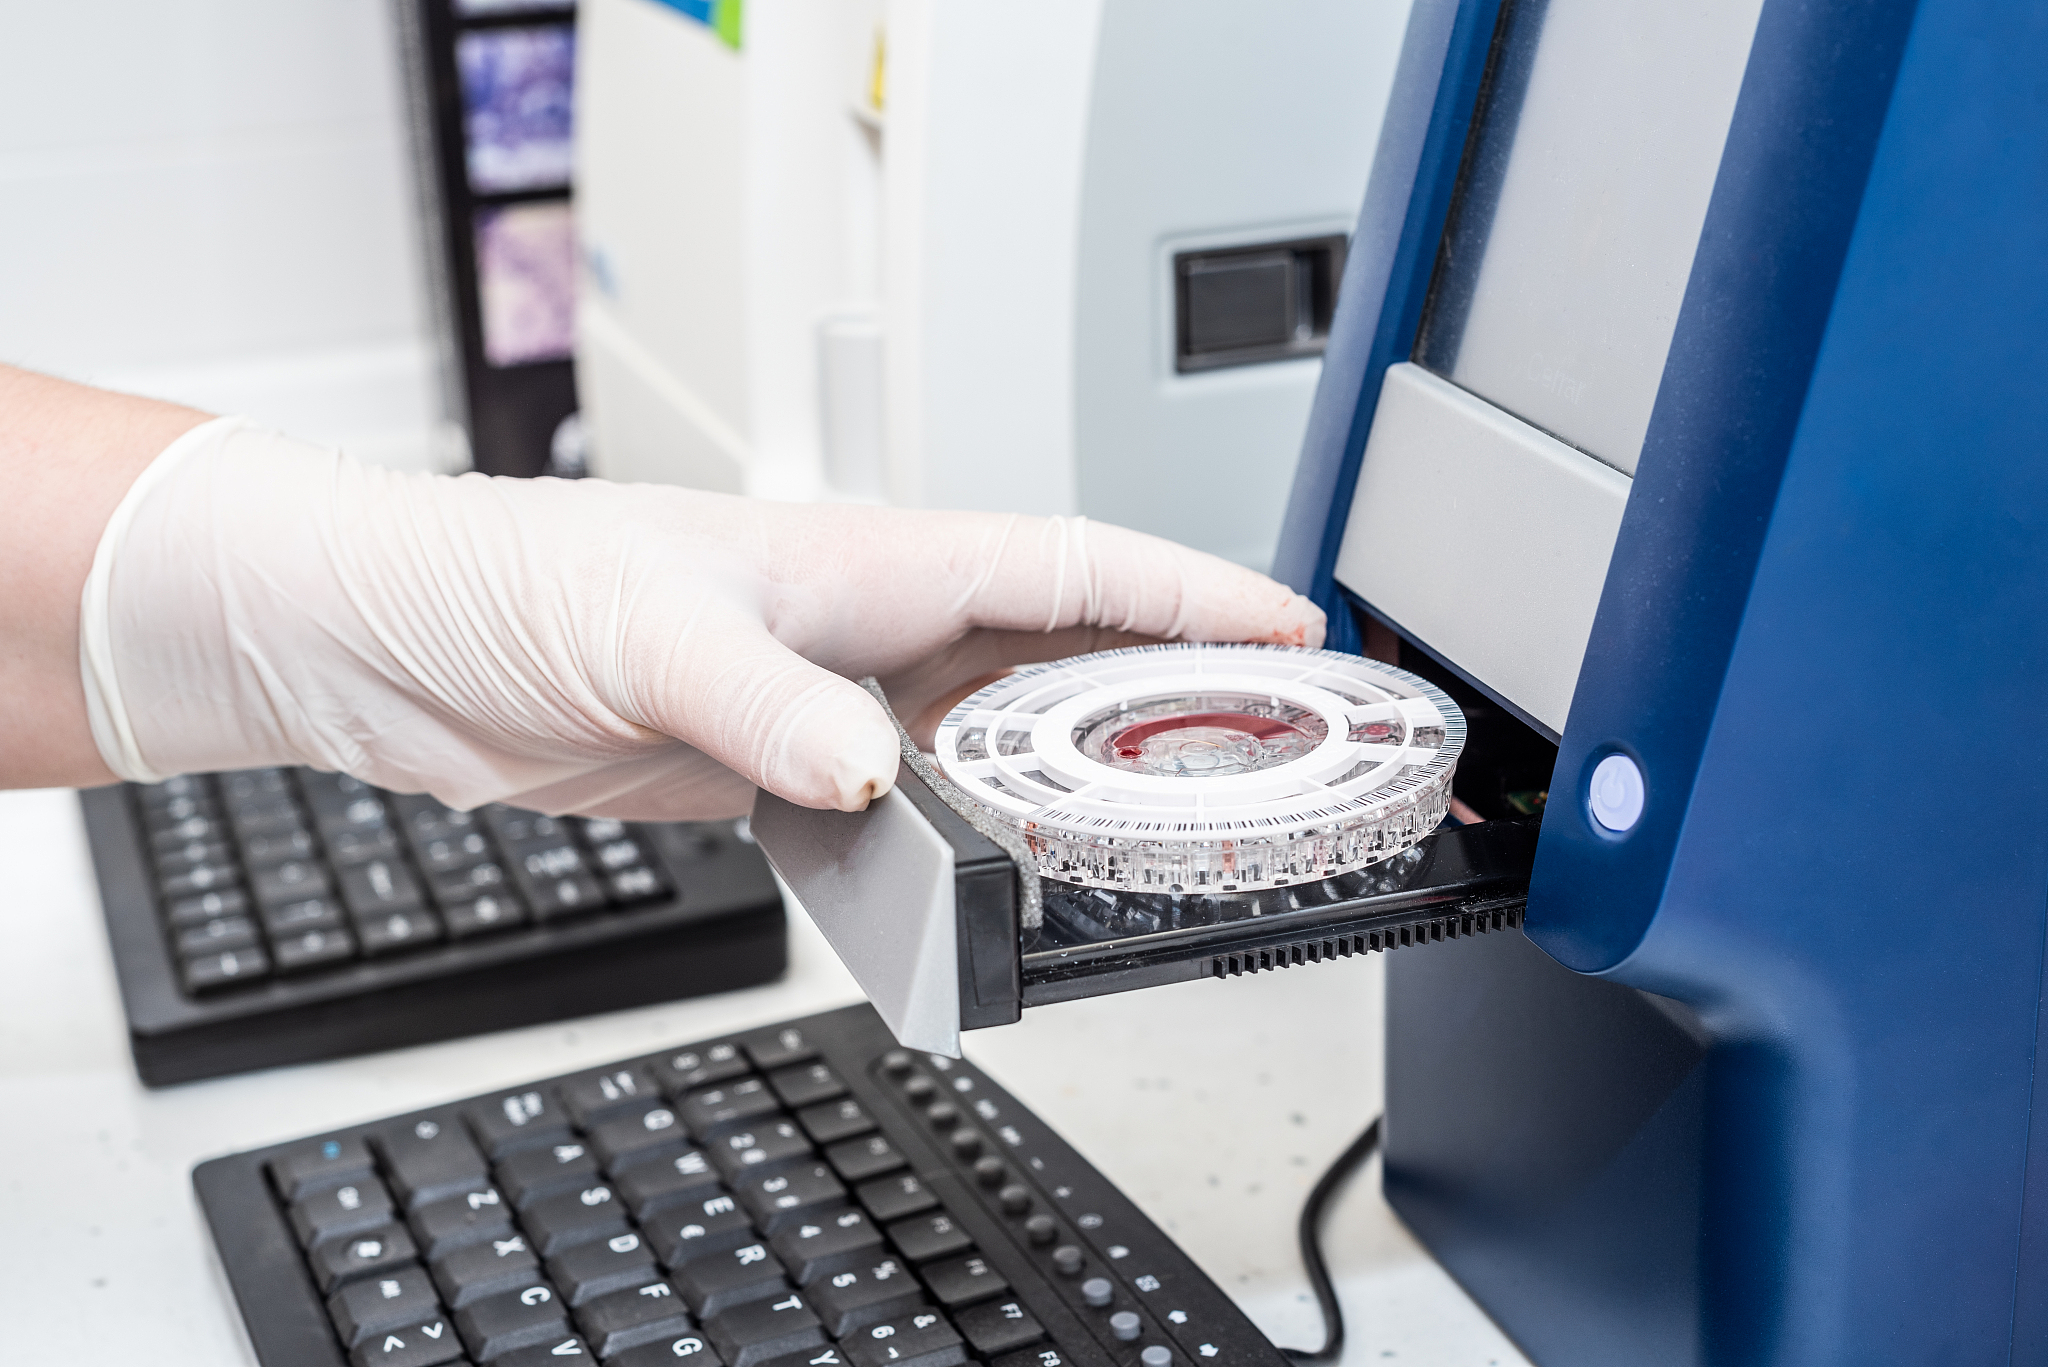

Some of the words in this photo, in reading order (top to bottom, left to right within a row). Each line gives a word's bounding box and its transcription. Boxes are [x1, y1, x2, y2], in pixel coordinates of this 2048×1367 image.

[730, 1135, 754, 1149] 2
[556, 1146, 582, 1162] A
[676, 1153, 706, 1174] W
[764, 1178, 787, 1192] 3
[468, 1190, 498, 1209] Z
[581, 1188, 610, 1205] S
[704, 1197, 734, 1215] E
[801, 1226, 820, 1238] 4
[495, 1237, 524, 1256] X
[609, 1234, 639, 1252] D
[736, 1245, 766, 1265] R
[872, 1261, 898, 1280] %
[833, 1274, 856, 1287] 5
[521, 1287, 550, 1305] C
[640, 1284, 670, 1297] F
[773, 1295, 802, 1310] T
[1001, 1304, 1023, 1318] F7
[914, 1315, 936, 1328] &
[872, 1326, 895, 1338] 6
[552, 1339, 581, 1355] V
[673, 1338, 702, 1356] G
[810, 1350, 839, 1365] Y
[1039, 1351, 1060, 1367] F8
